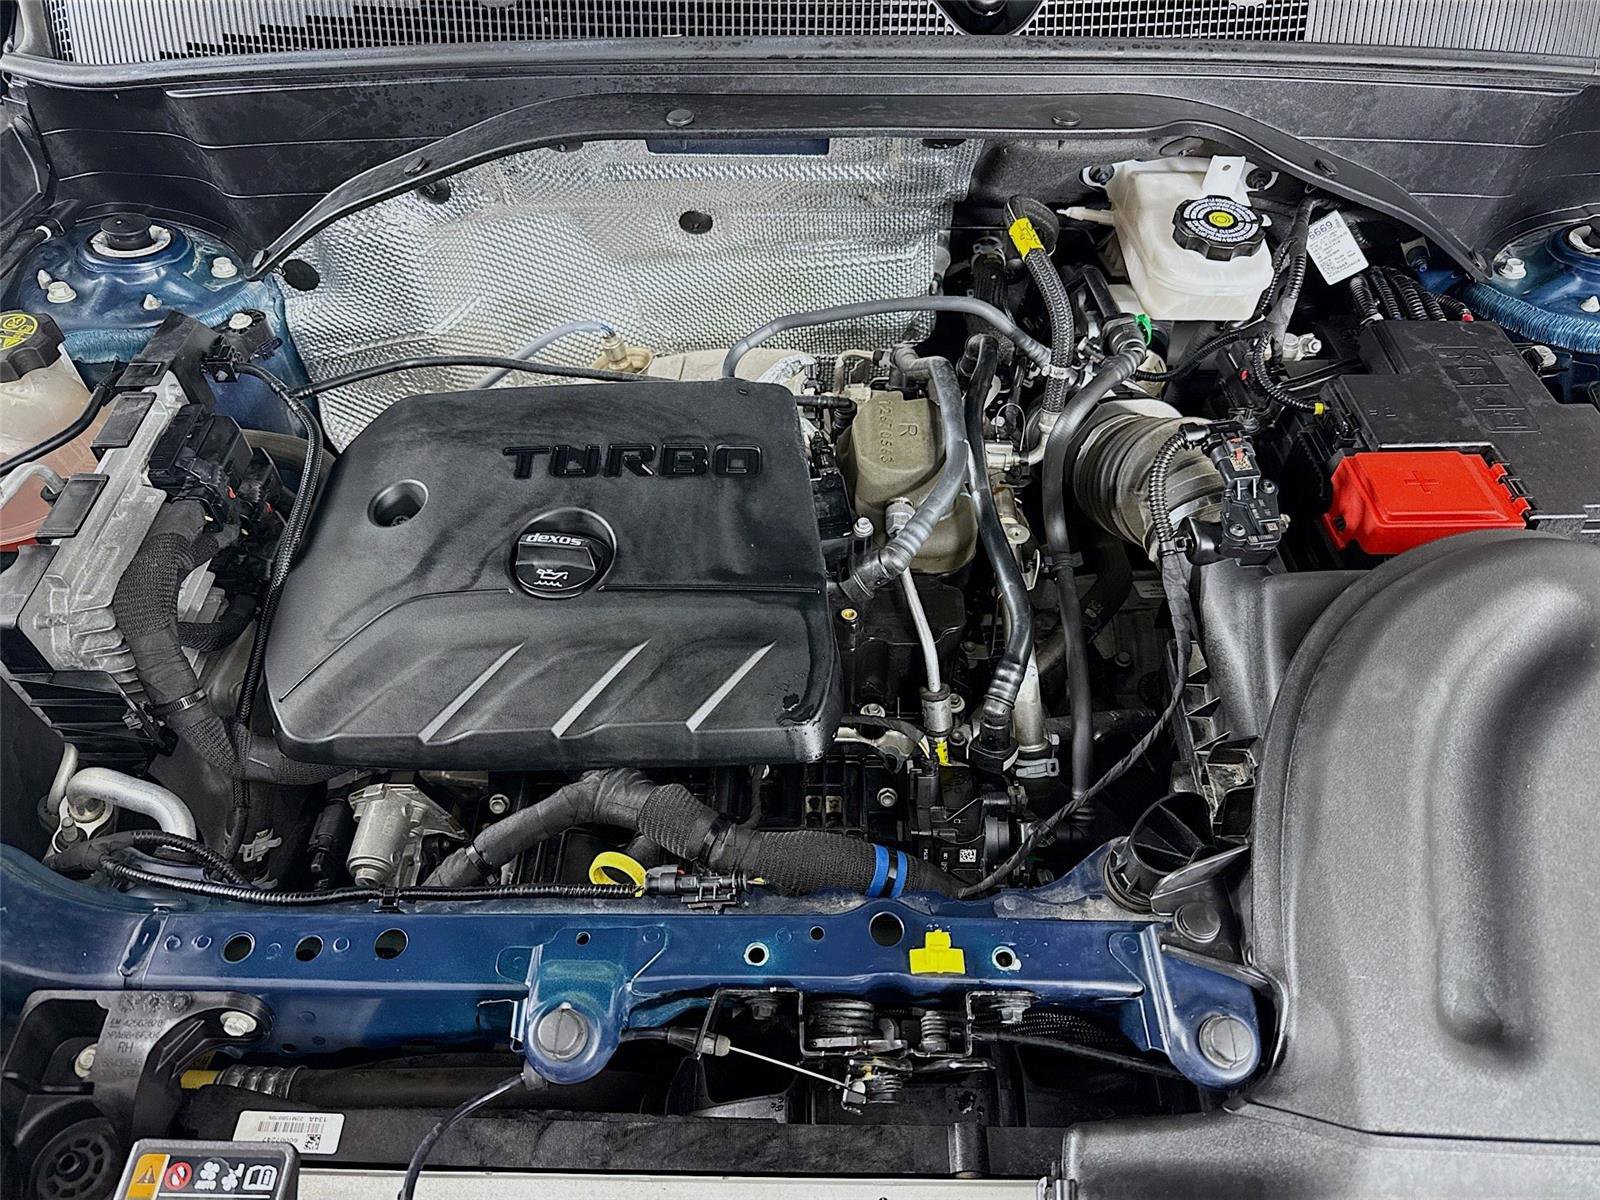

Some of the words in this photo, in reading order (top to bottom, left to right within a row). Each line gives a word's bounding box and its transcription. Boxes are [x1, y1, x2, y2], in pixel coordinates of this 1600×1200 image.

[1309, 221, 1333, 240] 6669
[899, 422, 918, 437] R
[503, 443, 762, 480] TURBO
[525, 532, 583, 547] dexos
[117, 1041, 134, 1054] RH
